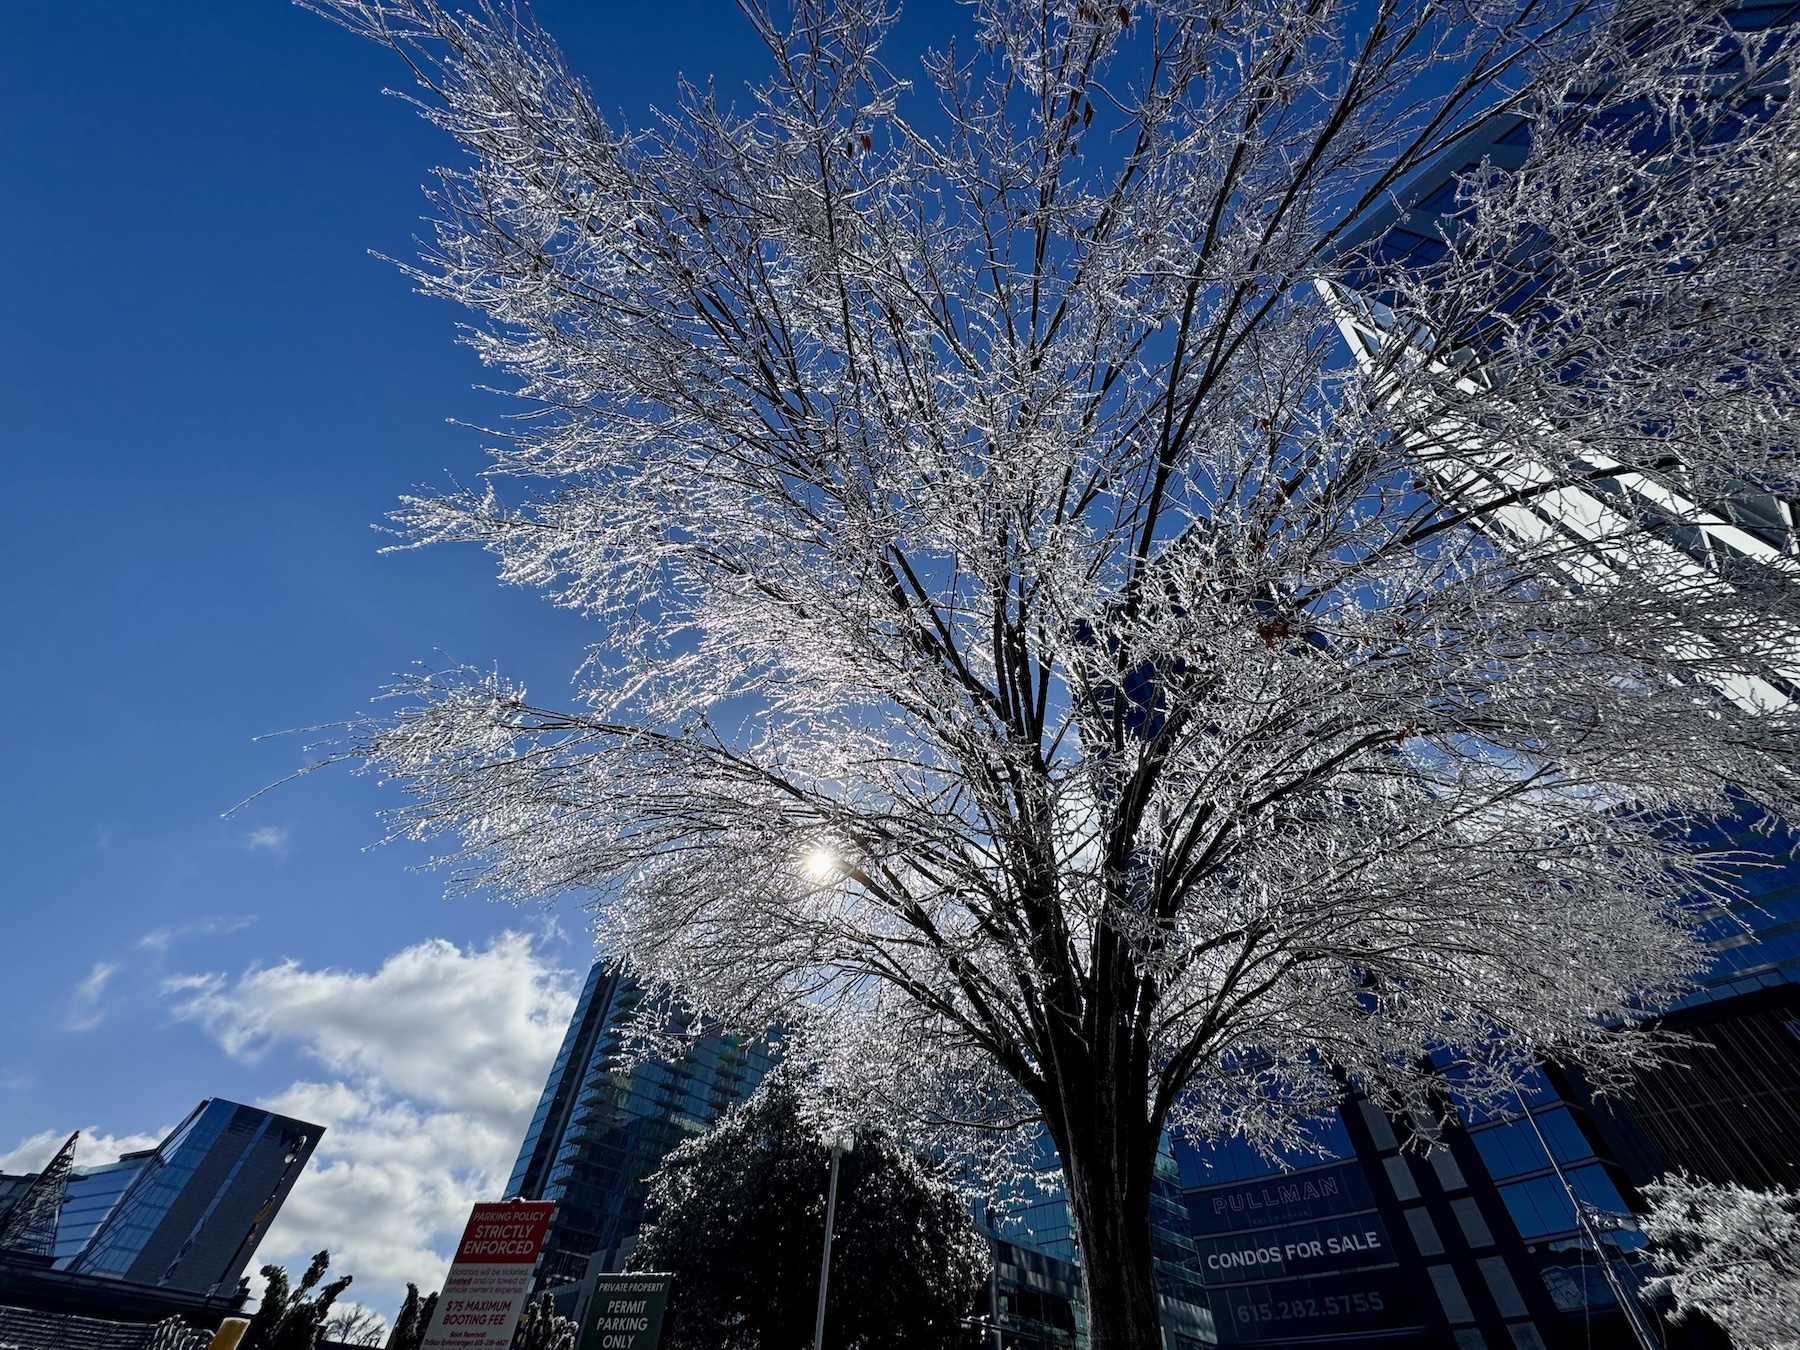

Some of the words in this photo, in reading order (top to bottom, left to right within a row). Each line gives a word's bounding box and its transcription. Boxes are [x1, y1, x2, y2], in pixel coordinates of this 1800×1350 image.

[1212, 1176, 1339, 1215] PULLMAN
[473, 1211, 512, 1222] PARKING
[512, 1211, 546, 1222] POLICY
[474, 1224, 535, 1239] STRICTLY
[463, 1240, 534, 1255] ENFORCED
[1207, 1246, 1282, 1270] CONDOS
[1285, 1240, 1324, 1261] FOR
[1327, 1231, 1381, 1256] SALE
[480, 1268, 491, 1276] will
[491, 1268, 501, 1276] be
[448, 1277, 473, 1286] booted
[473, 1277, 497, 1285] and/or
[497, 1277, 518, 1285] towed
[518, 1277, 527, 1285] at
[598, 1282, 628, 1292] PRIVATE
[628, 1282, 665, 1292] PROPERTY
[445, 1300, 465, 1312] $75
[465, 1300, 512, 1312] MAXIMUM
[607, 1300, 648, 1314] PERMIT
[1237, 1291, 1384, 1323] 615.282.5755
[442, 1313, 487, 1325] BOOTING
[487, 1313, 506, 1325] FEE
[596, 1316, 649, 1331] PARKING
[602, 1334, 636, 1349] ONLY
